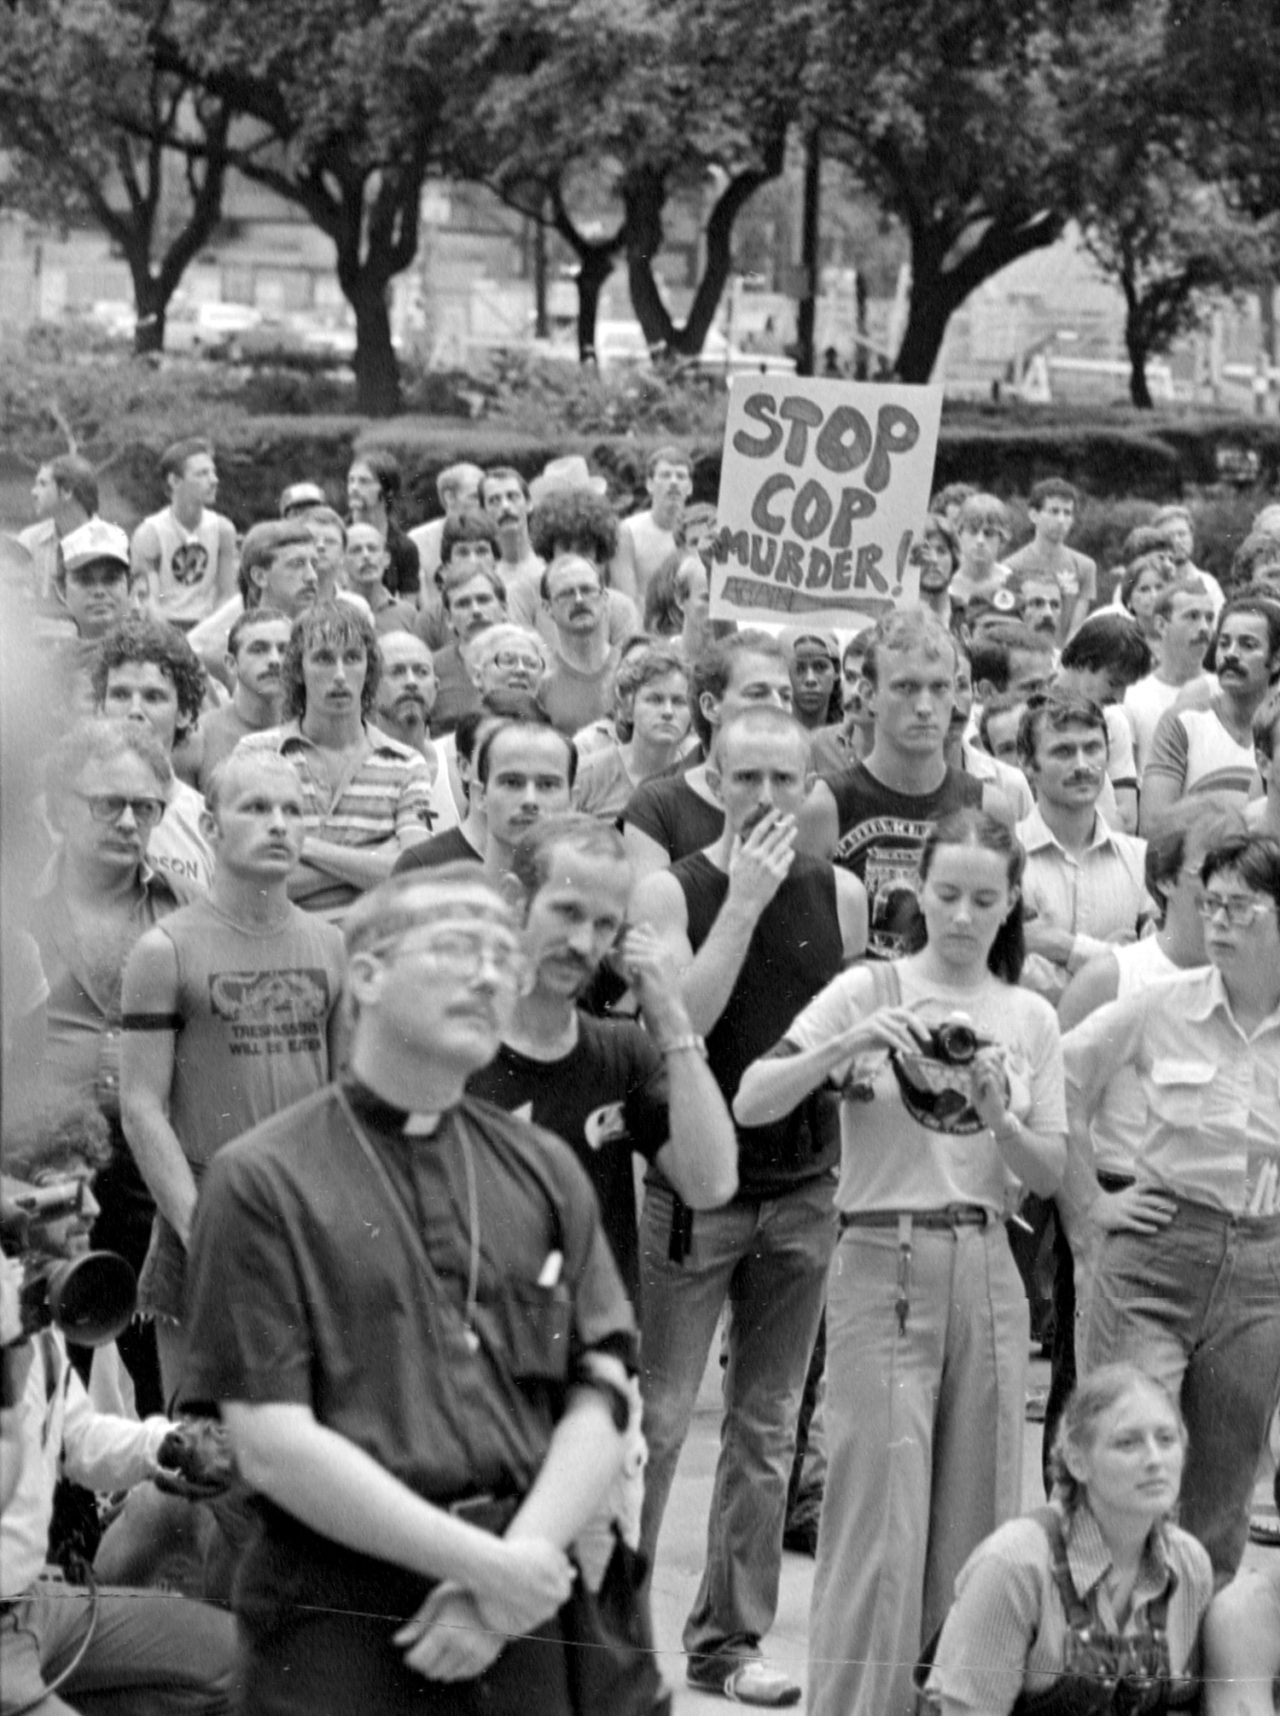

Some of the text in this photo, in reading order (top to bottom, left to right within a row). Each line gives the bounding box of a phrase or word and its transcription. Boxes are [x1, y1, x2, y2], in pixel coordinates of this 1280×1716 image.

[733, 393, 920, 494] STOP
[751, 473, 877, 549] COP
[228, 1041, 262, 1056] WILL
